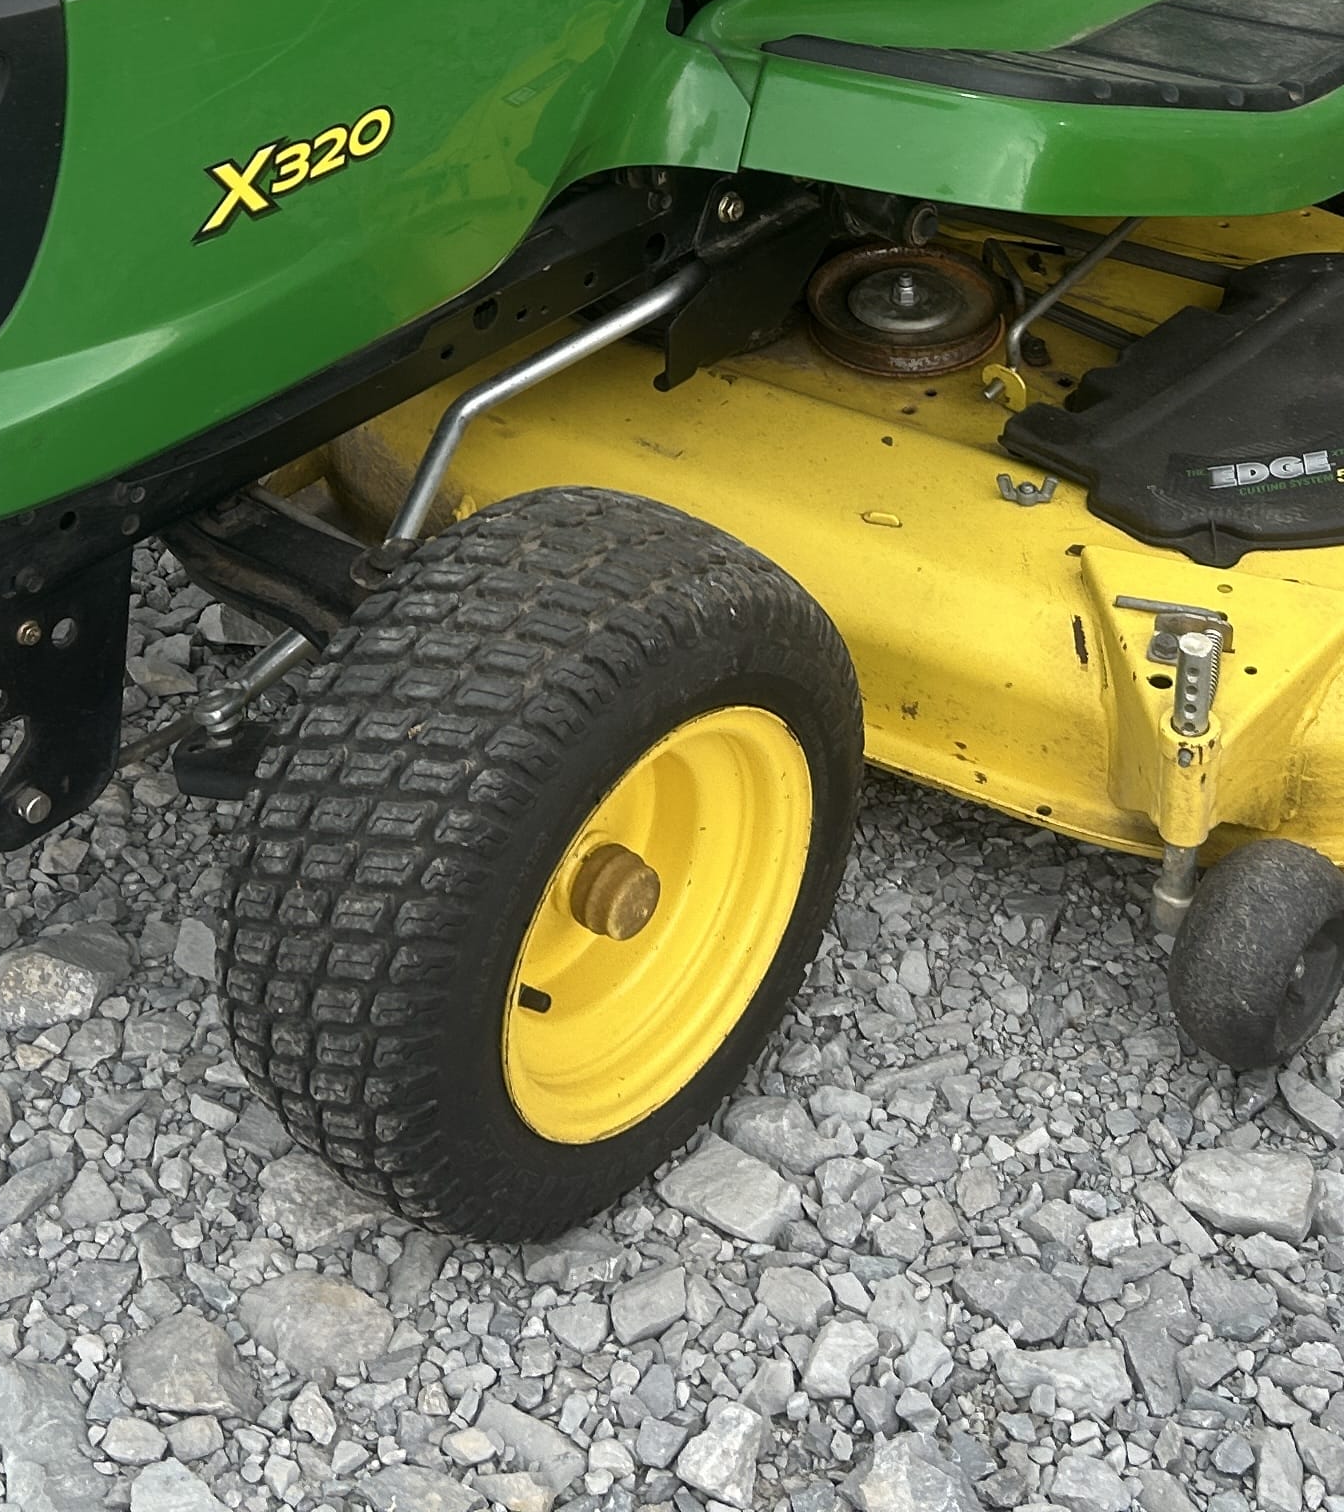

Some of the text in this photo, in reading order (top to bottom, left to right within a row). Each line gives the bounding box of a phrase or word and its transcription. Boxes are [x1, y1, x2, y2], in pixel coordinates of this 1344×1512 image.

[192, 105, 394, 244] X320
[1207, 450, 1332, 489] EDGE
[1239, 473, 1334, 496] CUTTING SYSTEM
